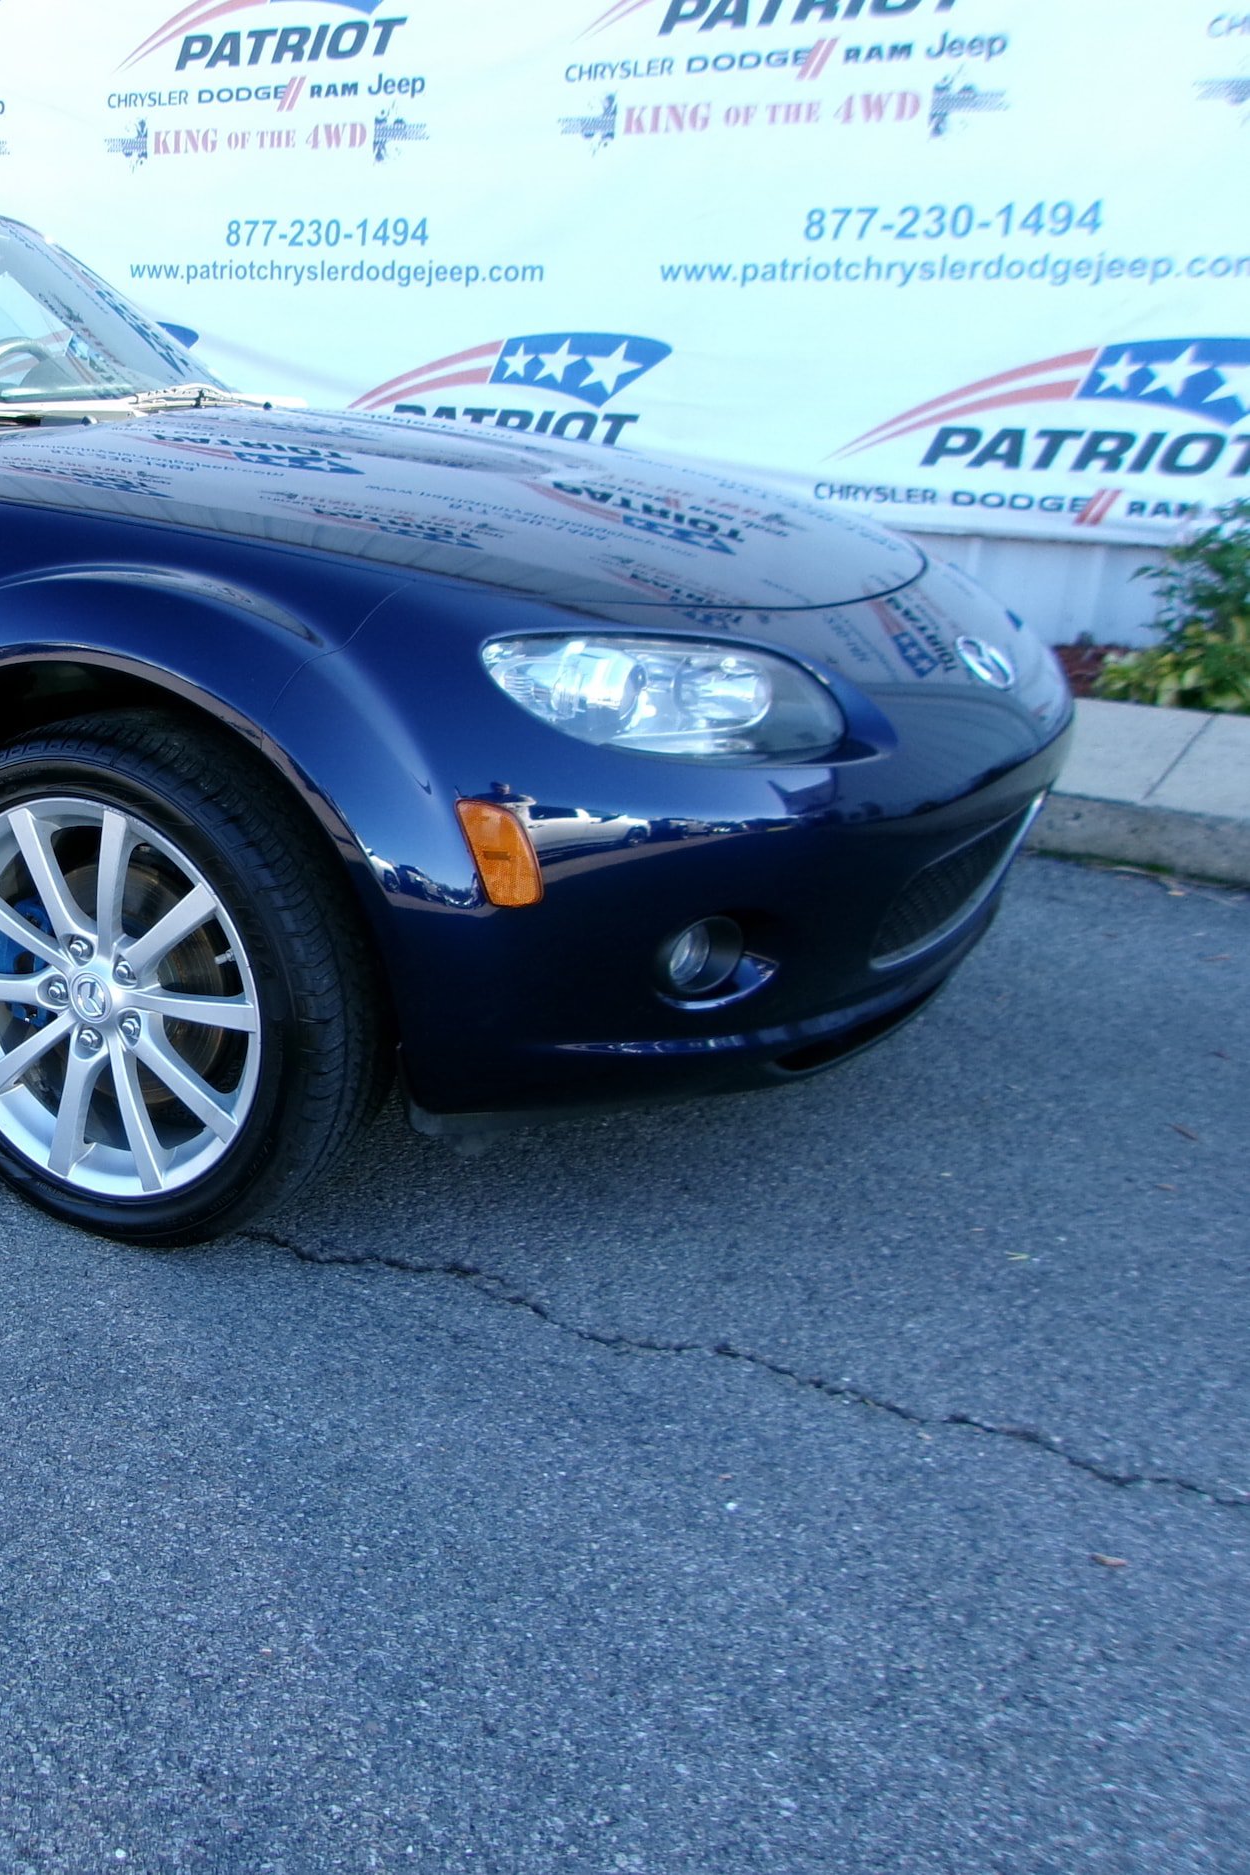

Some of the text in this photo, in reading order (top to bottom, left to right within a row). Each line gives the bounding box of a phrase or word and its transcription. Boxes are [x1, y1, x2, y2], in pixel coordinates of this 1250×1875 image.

[657, 0, 955, 36] PATR
[174, 16, 407, 72] PATRIOT
[564, 30, 1009, 83] CHRYSLER DODGE RAM Jeep
[107, 73, 426, 109] CHRYSLER DODGE RAM Jeep
[622, 90, 921, 135] KING OF THE 4WD
[153, 122, 367, 156] KING OF THE 4WD
[225, 217, 430, 248] 877-230-1494
[803, 198, 1104, 240] 877-230-1494
[130, 258, 544, 288] www.patriotchryslerdodgejeep.com
[814, 481, 937, 505] CHRYSLER
[951, 490, 1093, 514] DODGE
